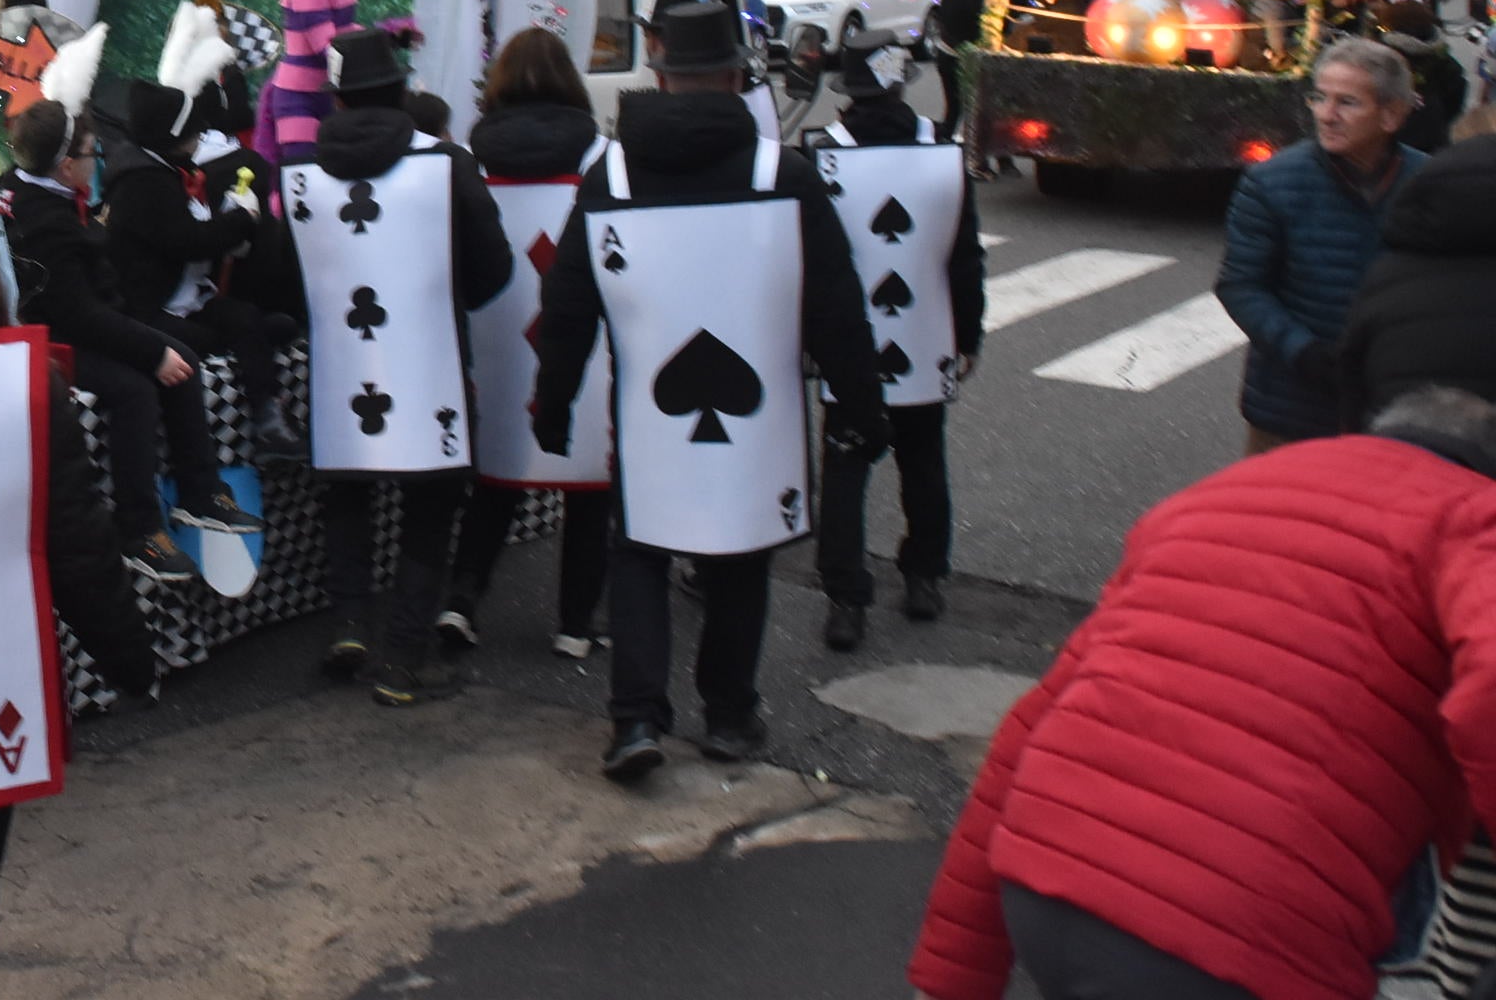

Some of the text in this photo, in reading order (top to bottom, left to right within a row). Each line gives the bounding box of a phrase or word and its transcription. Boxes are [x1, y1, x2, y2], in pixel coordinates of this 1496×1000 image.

[820, 152, 838, 176] 3
[290, 172, 307, 196] 3
[600, 224, 625, 251] A
[440, 431, 458, 458] 3
